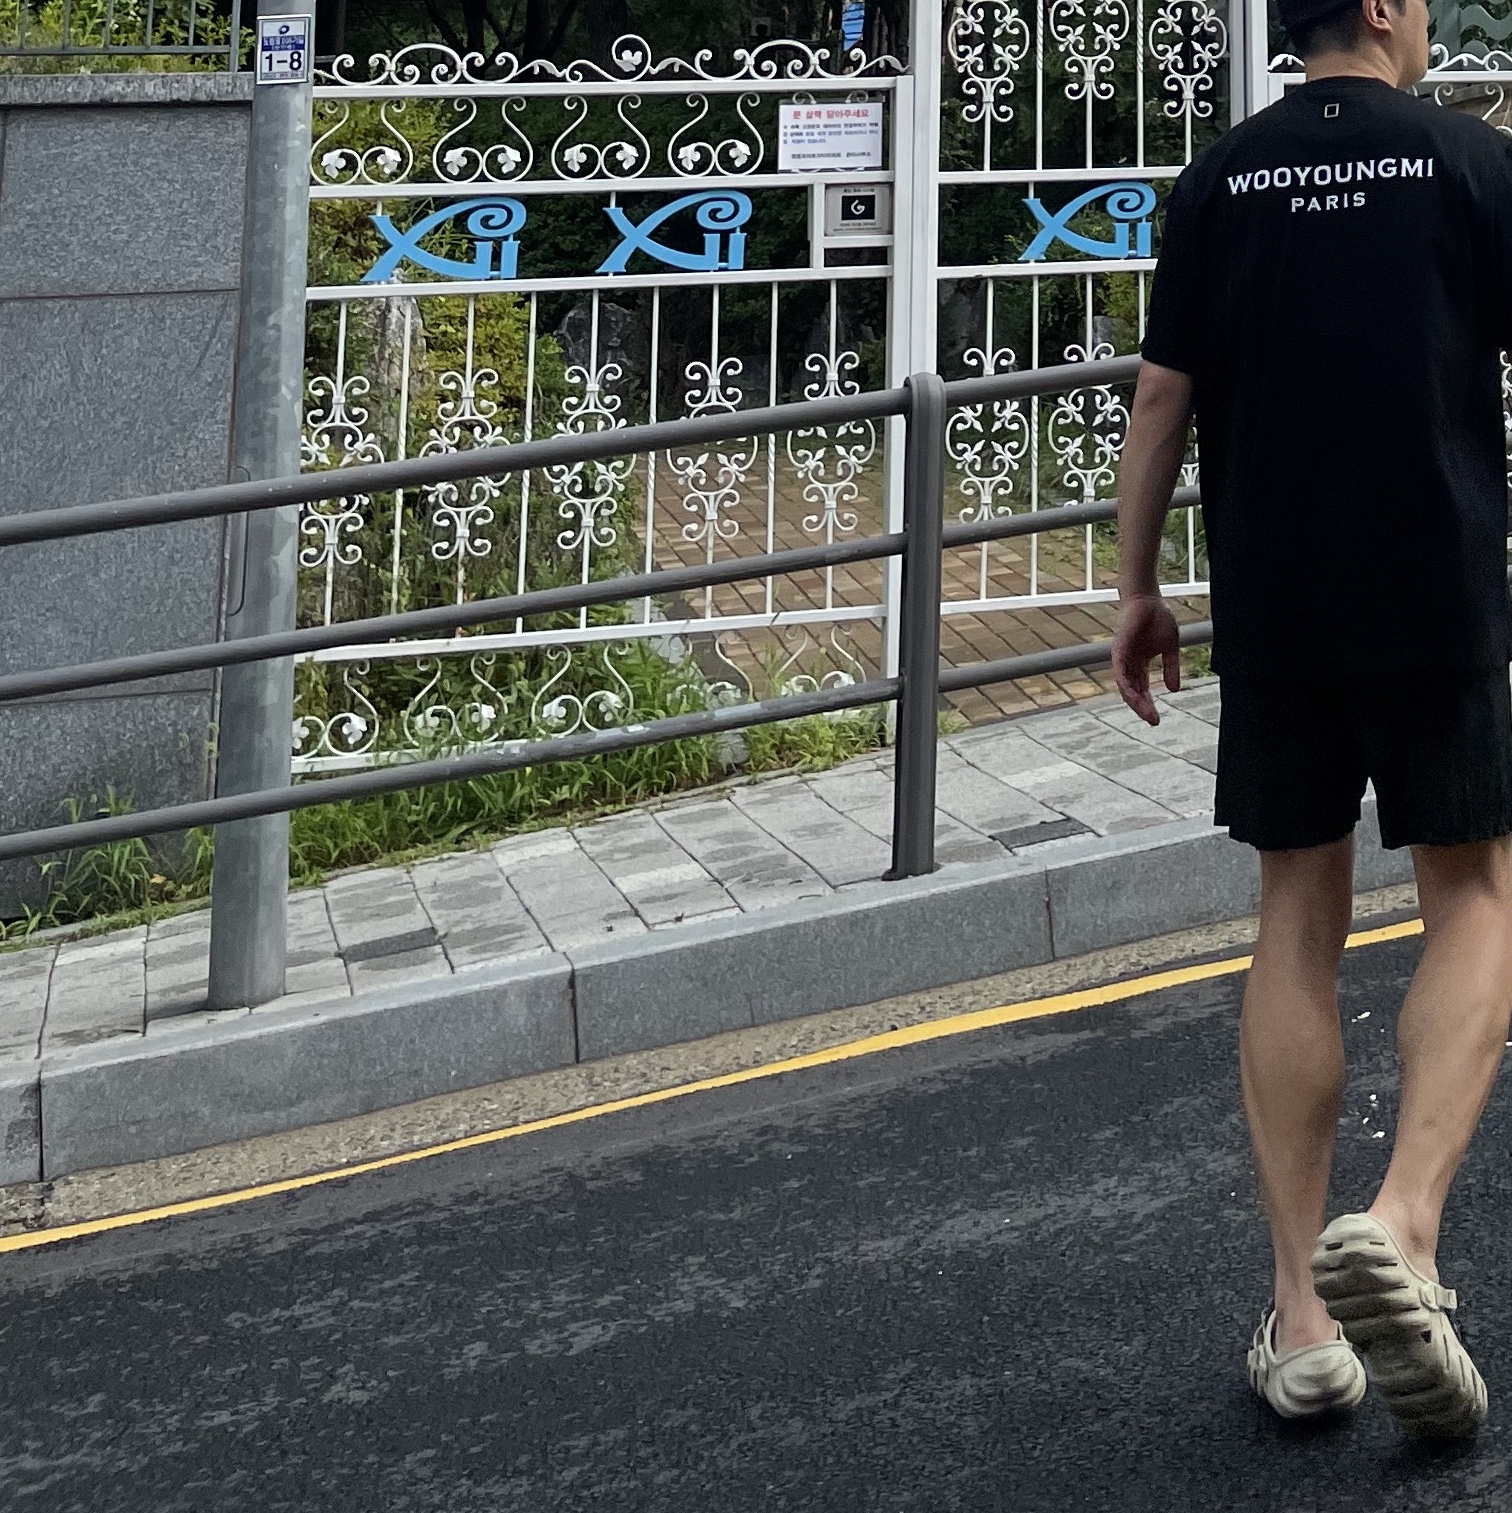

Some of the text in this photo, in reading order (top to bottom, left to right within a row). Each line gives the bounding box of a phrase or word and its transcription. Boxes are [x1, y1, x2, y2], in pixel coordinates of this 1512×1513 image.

[265, 51, 302, 71] 1-8
[1227, 157, 1434, 195] WOOYOUNGMI
[1290, 191, 1366, 213] PARIS
